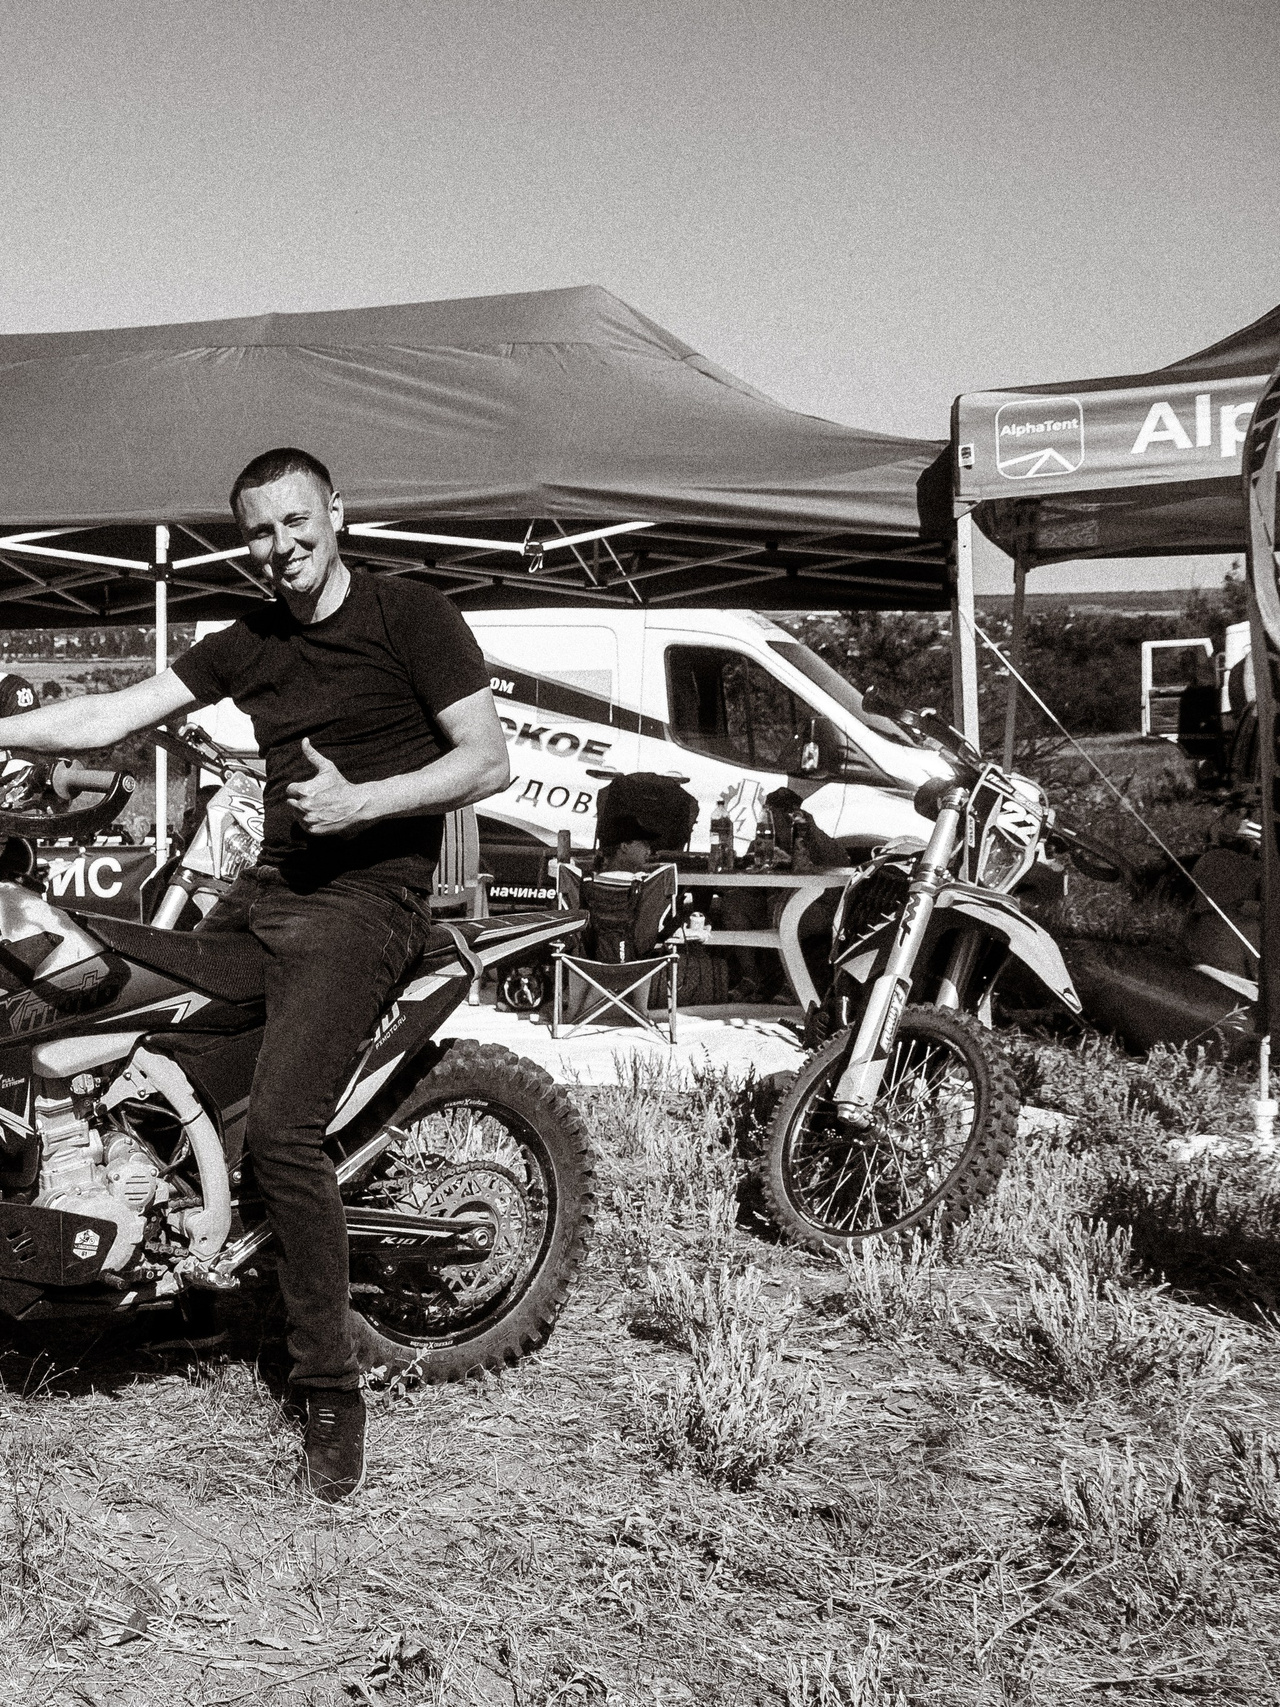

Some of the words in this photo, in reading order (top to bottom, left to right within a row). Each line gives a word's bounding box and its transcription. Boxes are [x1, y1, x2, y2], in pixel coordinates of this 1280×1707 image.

[999, 417, 1080, 438] AlphaTent
[1130, 393, 1258, 458] Alp
[508, 776, 598, 818] ДОВ
[489, 886, 556, 900] начинае
[380, 1236, 417, 1245] K10
